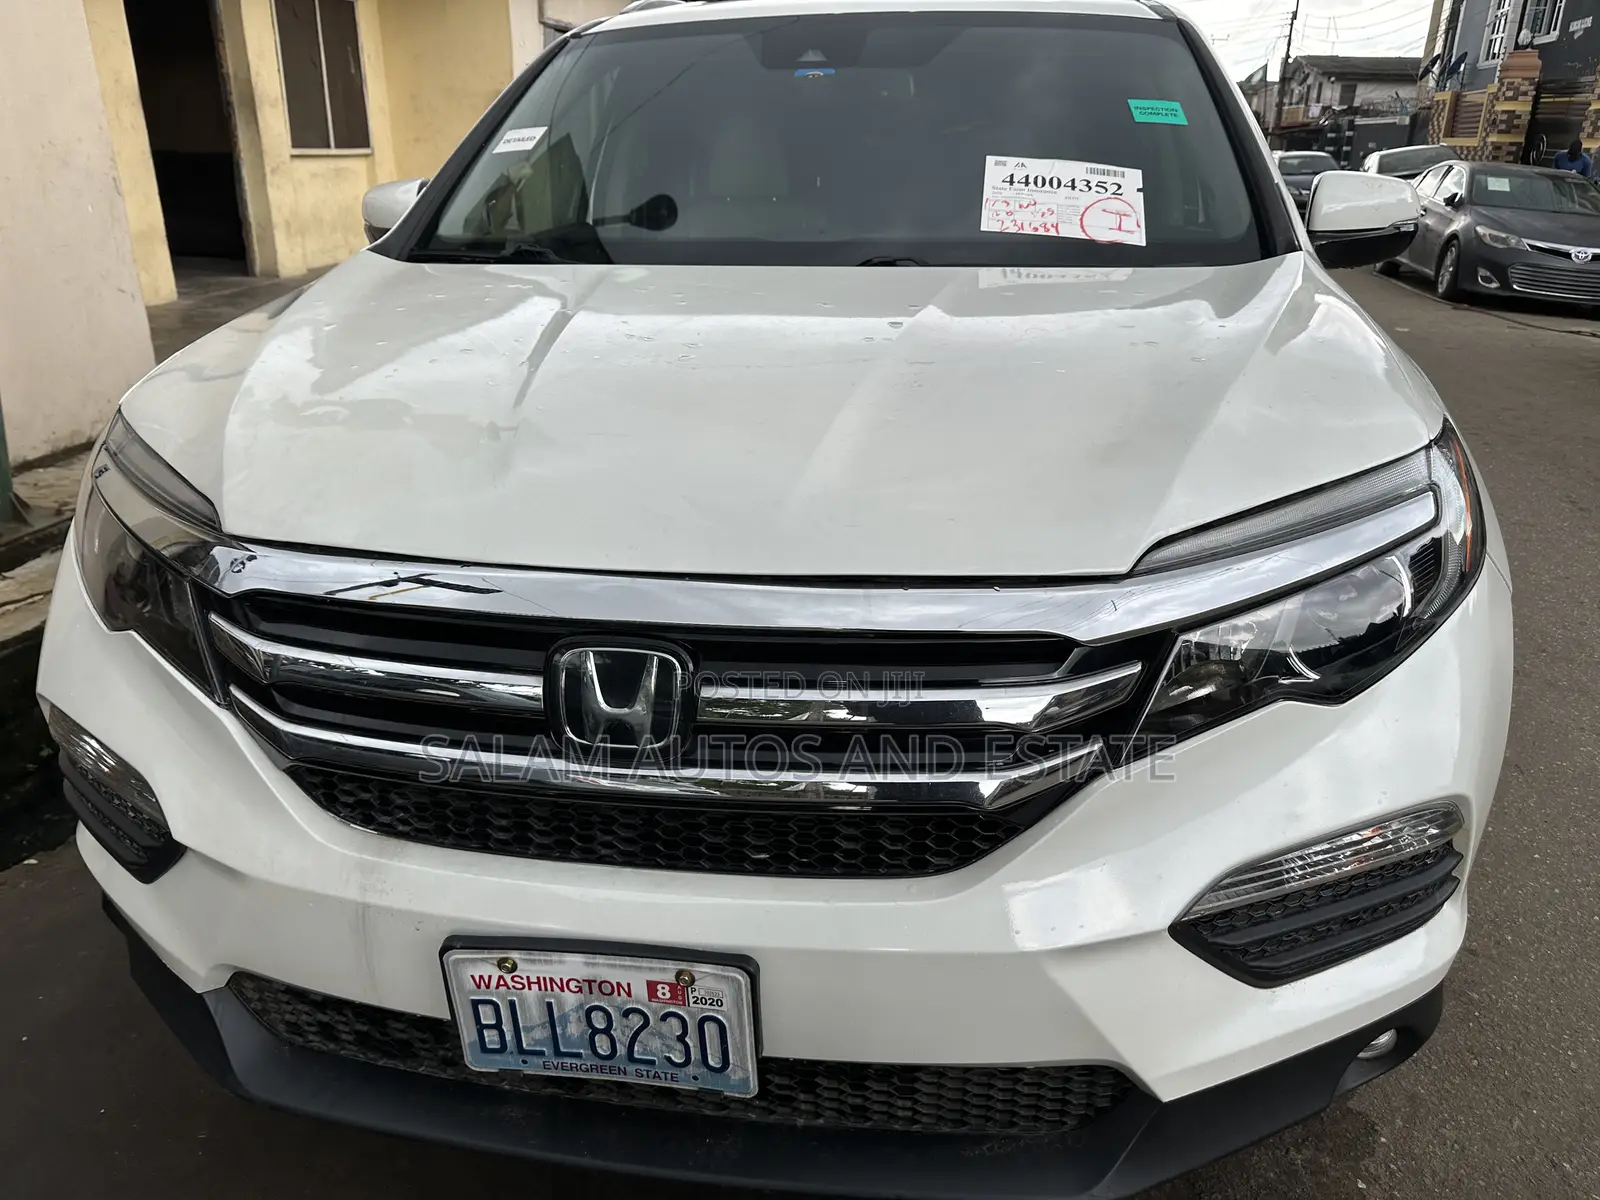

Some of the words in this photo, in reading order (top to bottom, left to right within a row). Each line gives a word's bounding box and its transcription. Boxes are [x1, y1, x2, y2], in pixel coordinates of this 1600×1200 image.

[502, 136, 537, 144] DETAILED
[1001, 173, 1124, 196] 44004352
[470, 974, 633, 999] WASHINGTON
[656, 983, 671, 999] 8
[690, 987, 697, 995] P
[692, 995, 724, 1008] 2020
[470, 997, 732, 1074] BLL8230
[542, 1060, 628, 1077] EVERGREEN
[635, 1068, 680, 1083] STATE
